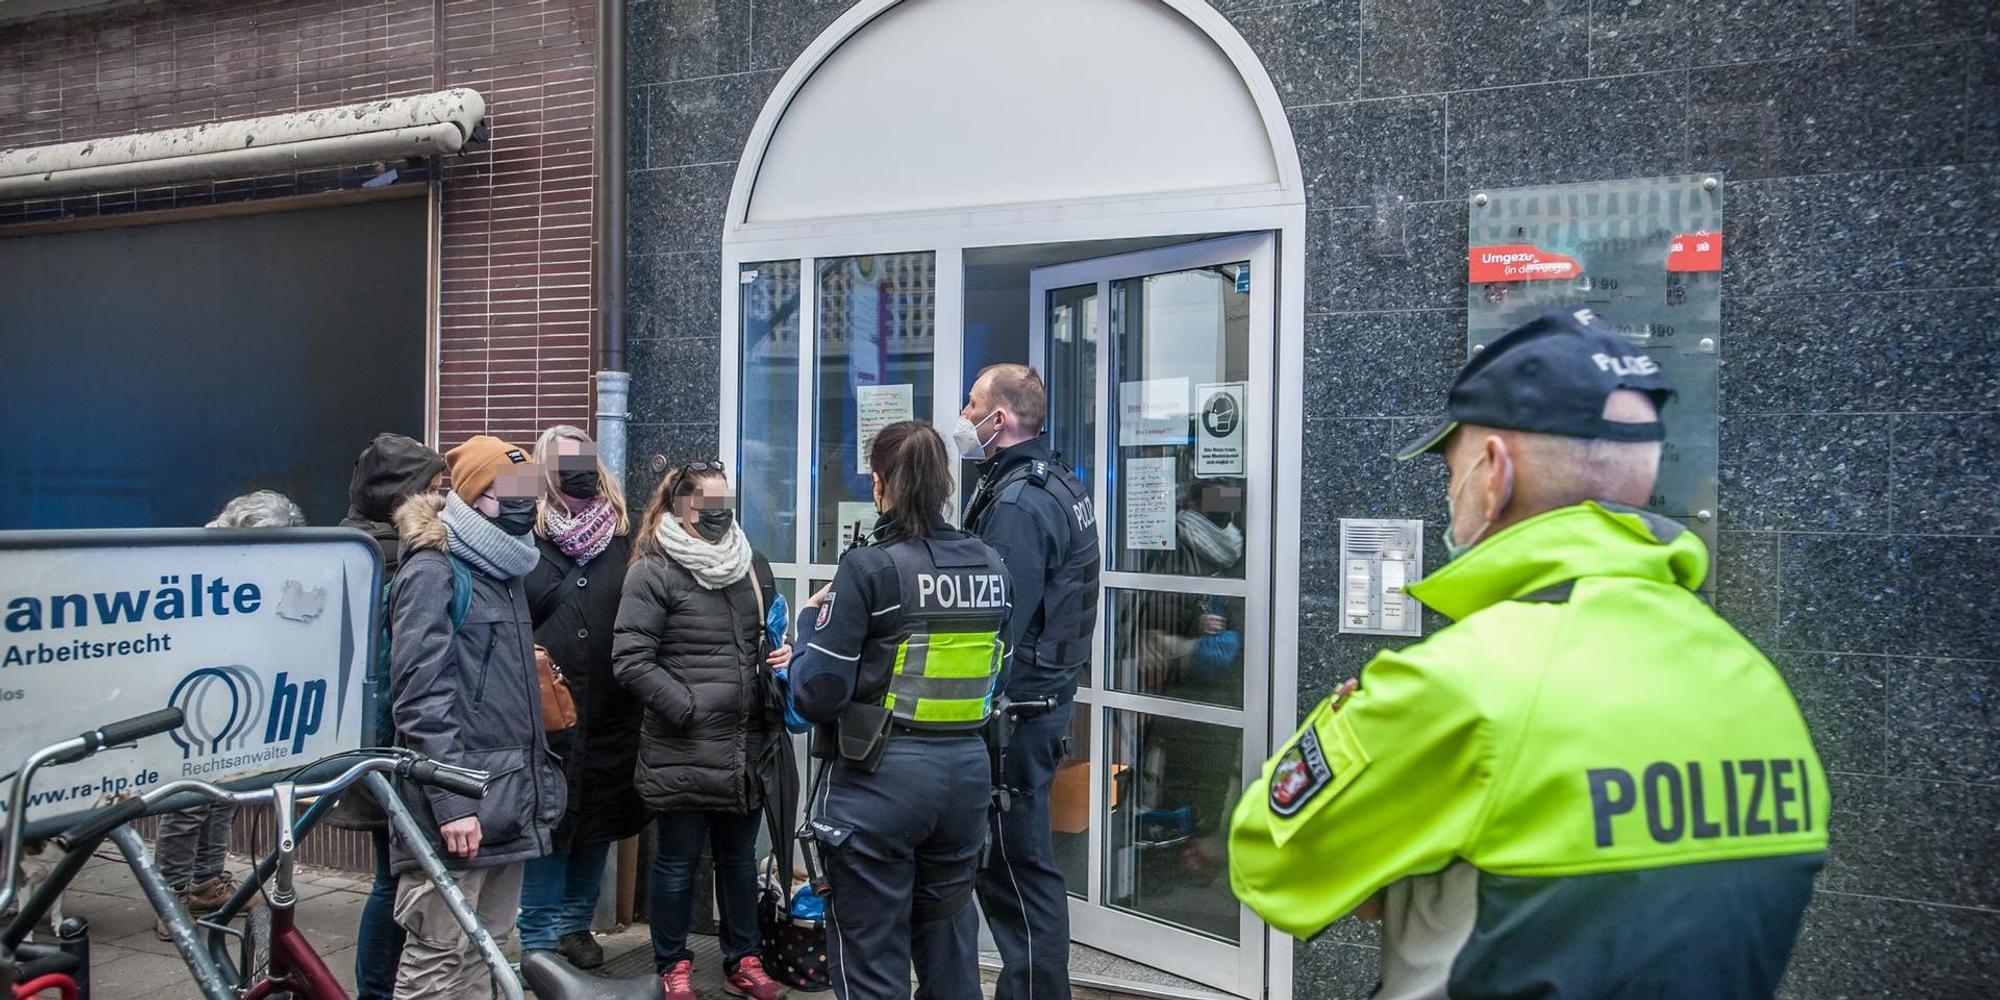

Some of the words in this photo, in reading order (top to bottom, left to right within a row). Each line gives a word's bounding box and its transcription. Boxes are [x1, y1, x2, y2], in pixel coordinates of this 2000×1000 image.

[4, 573, 262, 633] anwälte
[918, 573, 1005, 608] POLIZEI
[2, 633, 171, 668] Arbeitsrecht
[264, 671, 327, 756] hp
[182, 746, 289, 777] Rechtsanwälte
[1586, 758, 1812, 848] POLIZEI
